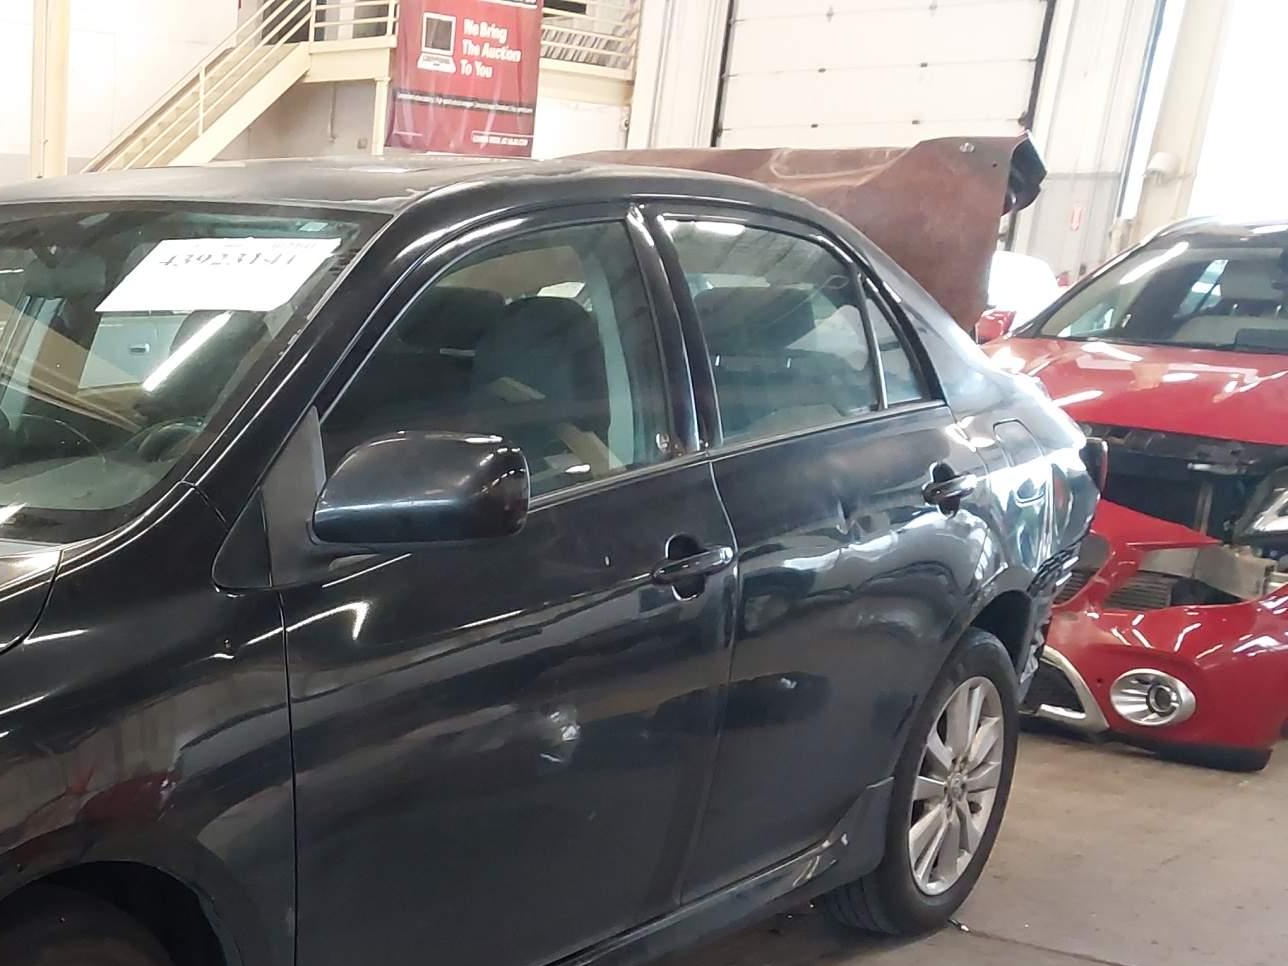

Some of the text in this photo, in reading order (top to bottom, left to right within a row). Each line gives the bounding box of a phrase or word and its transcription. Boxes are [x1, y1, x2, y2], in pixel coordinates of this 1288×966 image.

[463, 18, 508, 44] We Bring
[462, 39, 522, 63] The Auction
[459, 59, 493, 78] To You
